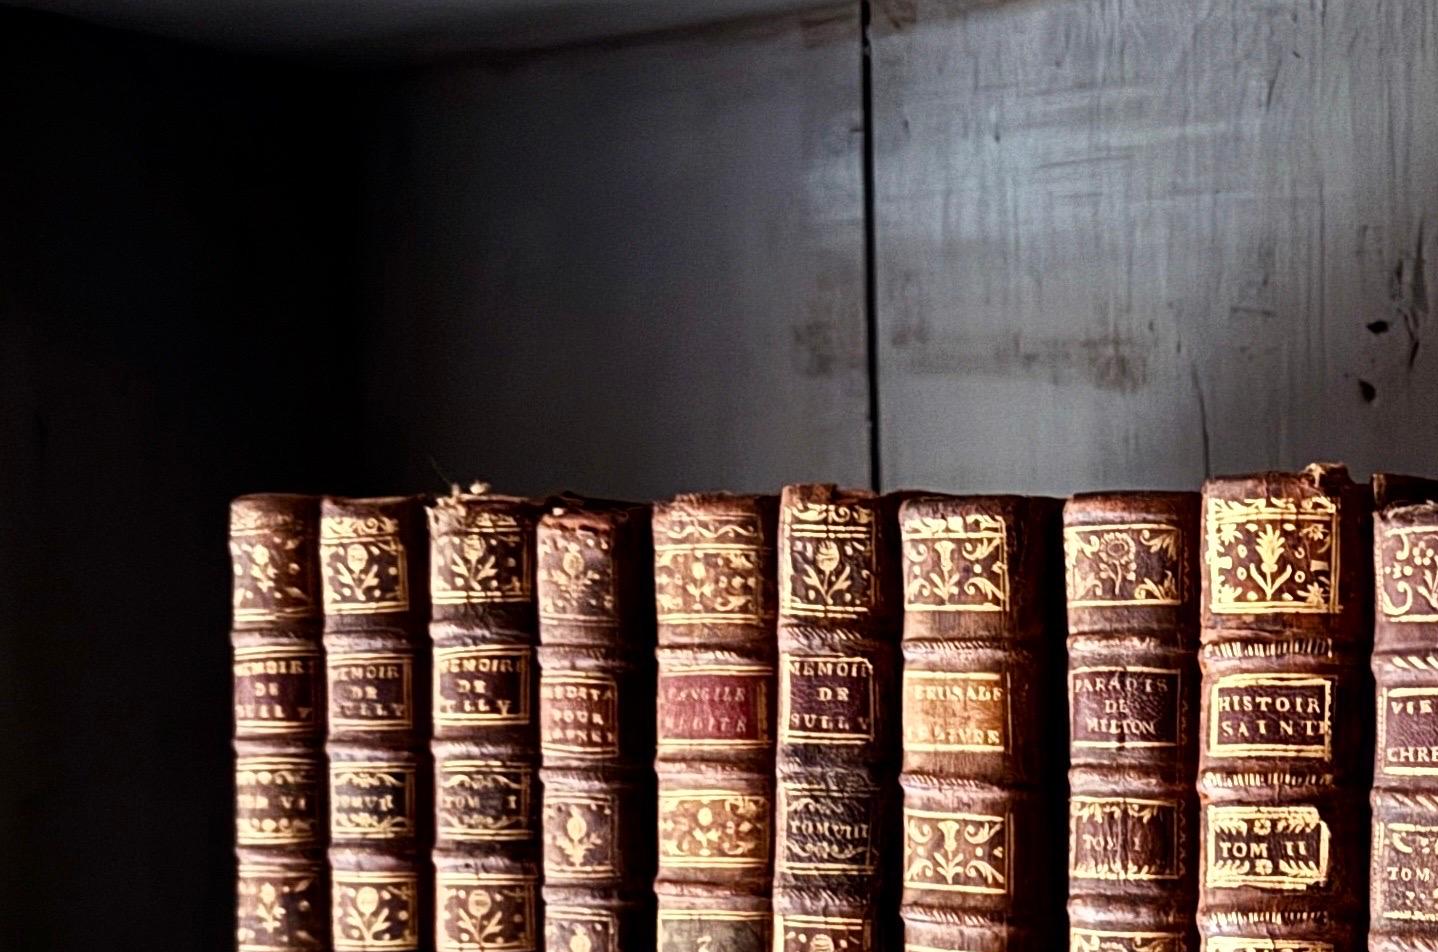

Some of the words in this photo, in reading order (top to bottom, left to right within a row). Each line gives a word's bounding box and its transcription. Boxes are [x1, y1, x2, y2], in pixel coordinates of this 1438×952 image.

[457, 680, 486, 693] DE
[1075, 676, 1168, 692] PARADIS
[818, 686, 849, 701] DE
[1105, 699, 1129, 713] DE
[1219, 696, 1320, 713] HISTOIR
[551, 709, 604, 725] POUR
[791, 713, 870, 730] SULLY
[1086, 717, 1156, 734] MILTON
[507, 796, 517, 809] I
[1083, 835, 1119, 850] TOM
[1219, 841, 1268, 858] TOM
[1285, 841, 1307, 856] II
[1387, 867, 1430, 881] TOM
